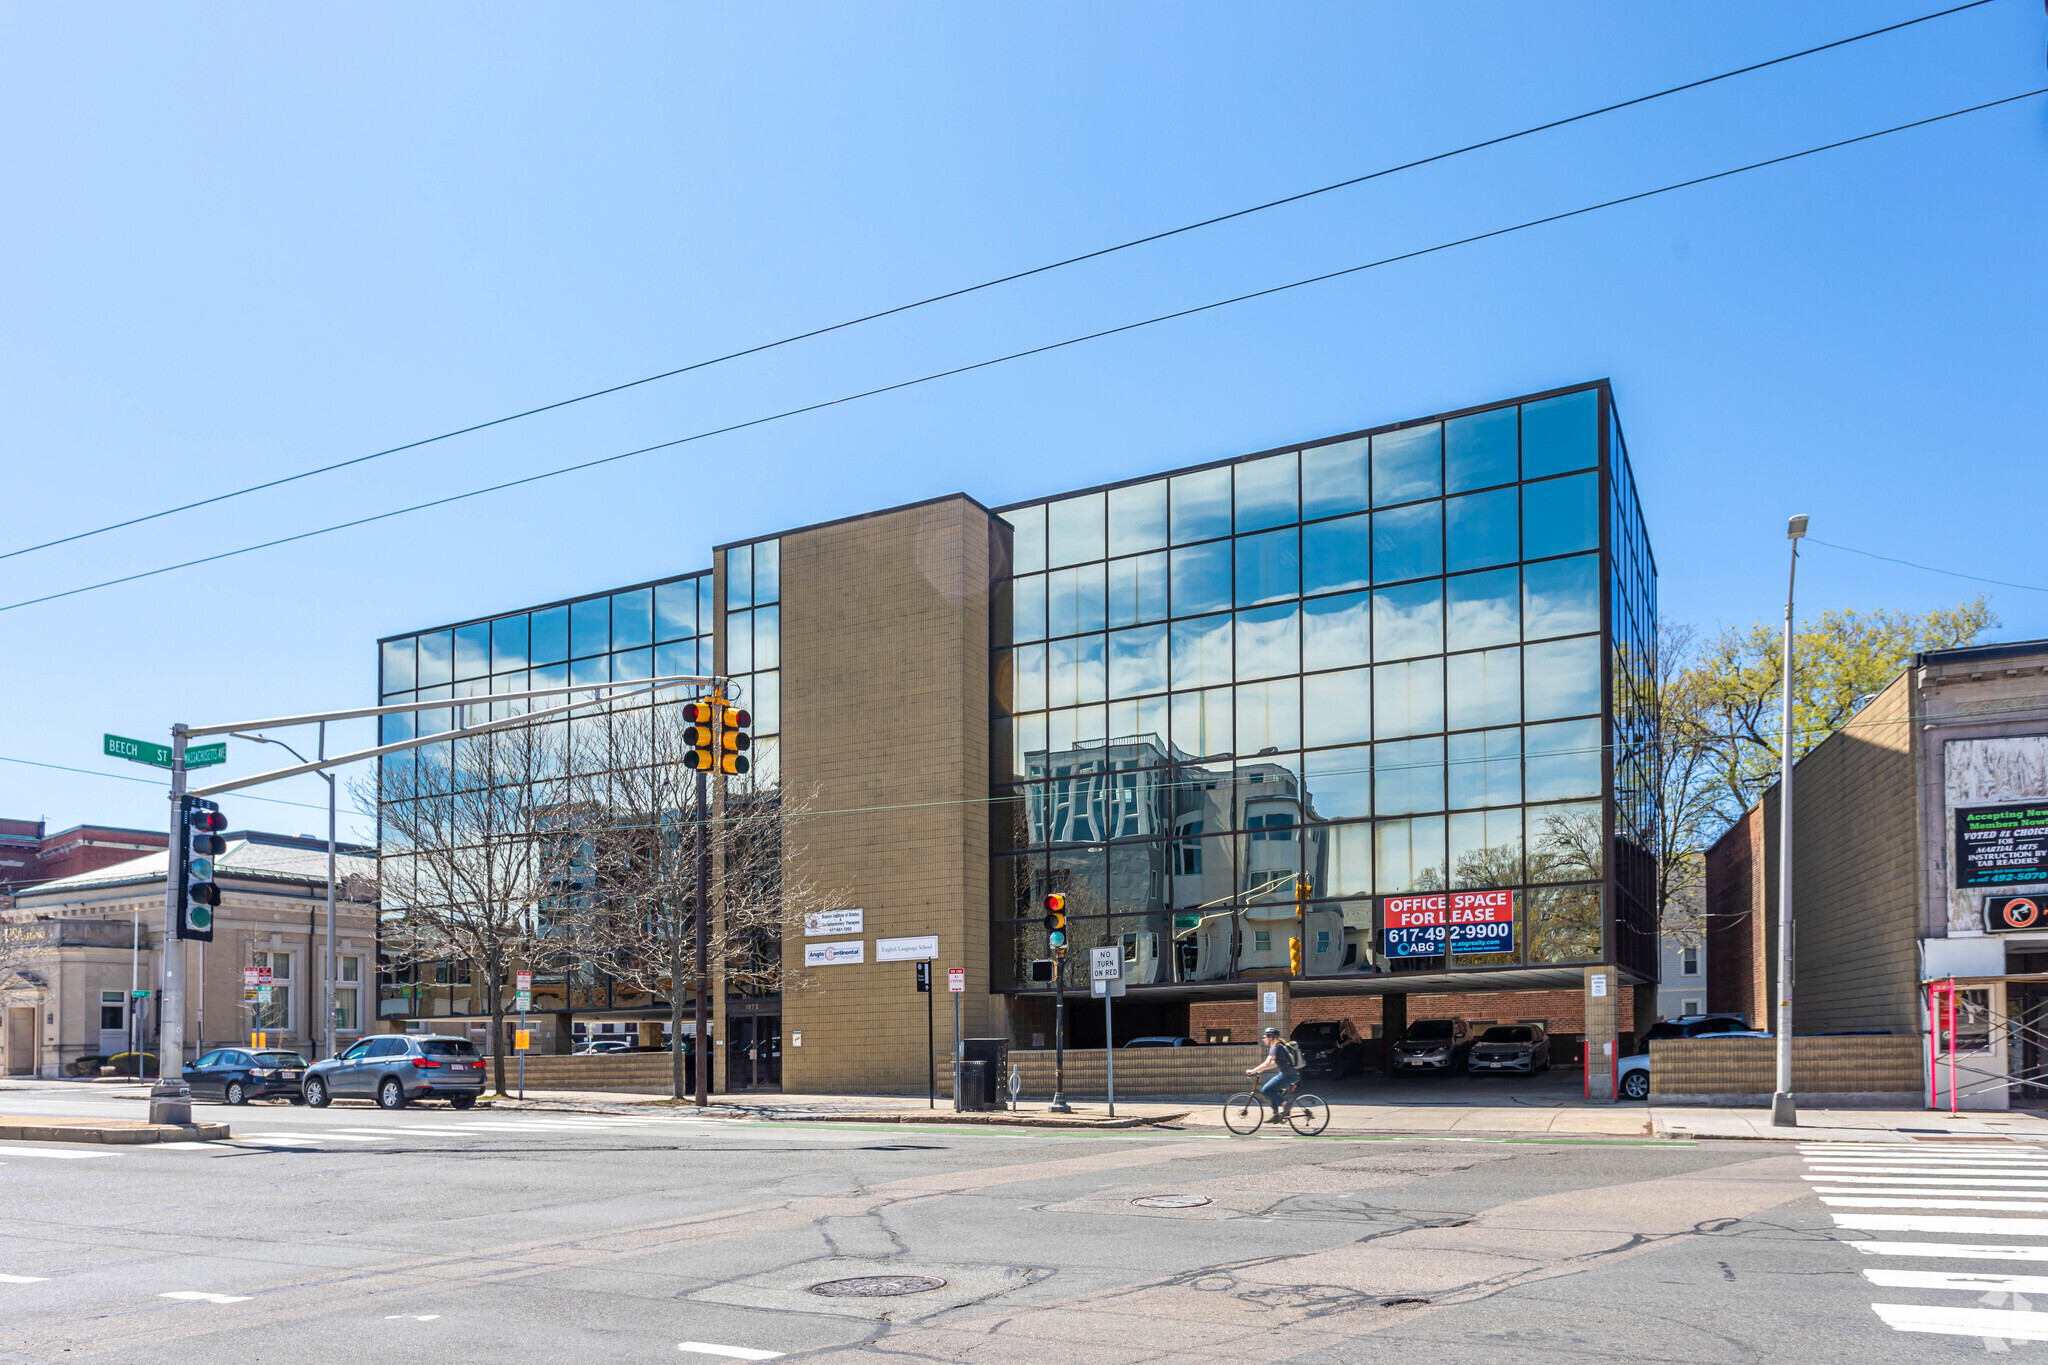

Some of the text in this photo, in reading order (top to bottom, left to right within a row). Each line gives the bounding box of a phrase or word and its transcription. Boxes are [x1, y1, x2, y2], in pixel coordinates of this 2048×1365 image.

[109, 739, 168, 762] BEECH ST
[1966, 811, 2024, 821] Accepting
[1969, 821, 2019, 830] Members
[1963, 831, 1997, 840] VOTED
[1976, 843, 2039, 853] MARTIAL ARTS
[1968, 851, 2032, 861] INSTRUCTION
[1996, 857, 2039, 866] READERS
[1991, 871, 2048, 882] 492-5070
[1390, 893, 1507, 912] OFFICE SPACE
[1401, 908, 1495, 926] FOR LEASE
[1388, 923, 1509, 943] 617-492-9900
[1409, 942, 1435, 953] ABG
